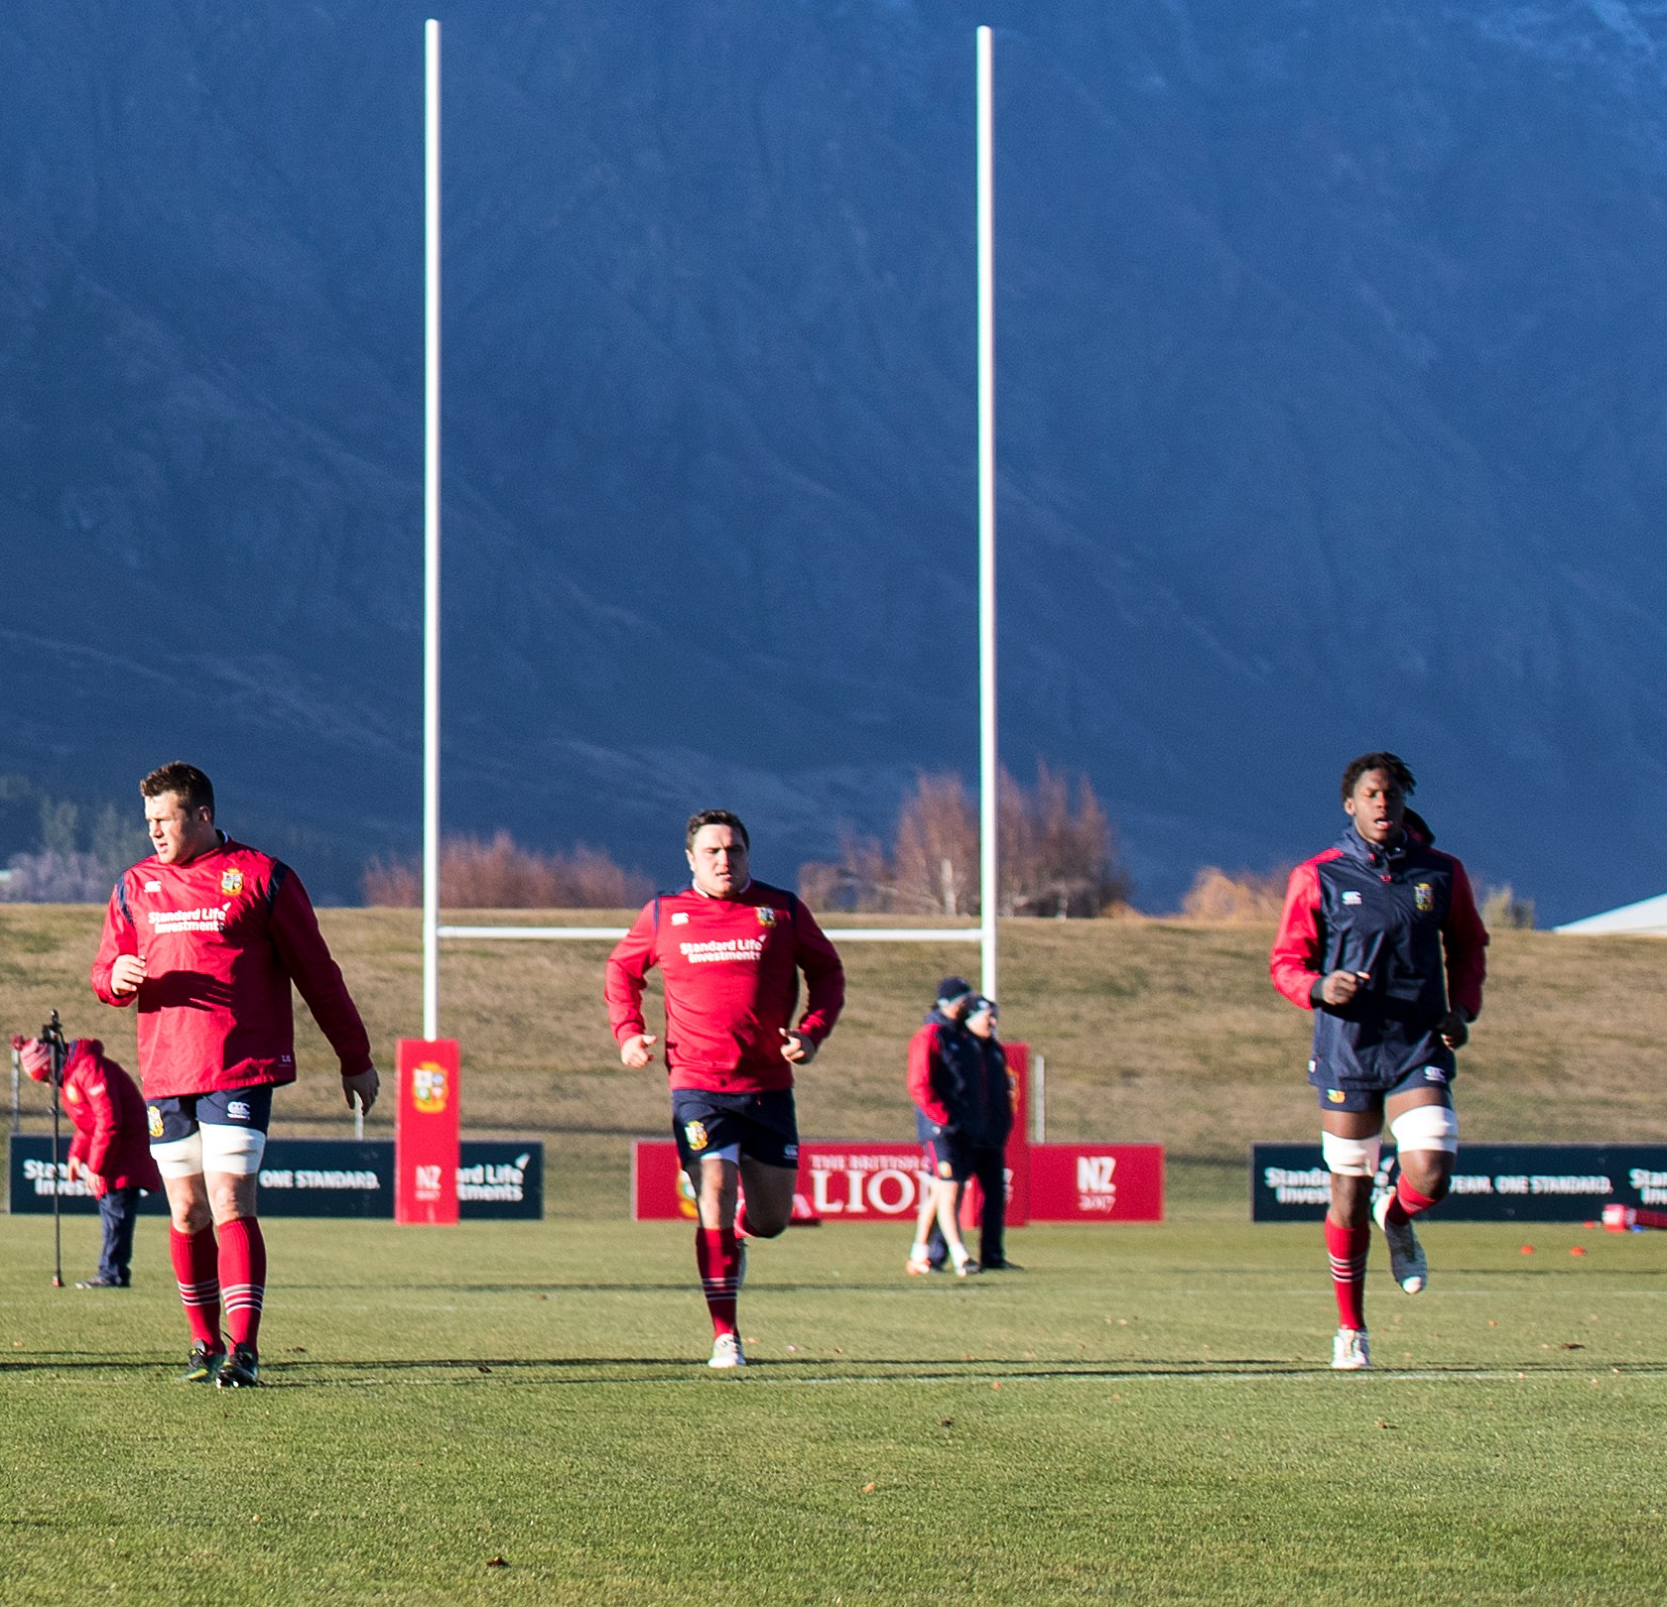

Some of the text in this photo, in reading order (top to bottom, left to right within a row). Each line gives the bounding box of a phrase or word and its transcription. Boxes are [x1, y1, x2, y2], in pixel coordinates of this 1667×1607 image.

[148, 907, 225, 924] Standard Life
[680, 939, 762, 955] Standard Life
[259, 1170, 380, 1189] ONE STANDARD.
[415, 1165, 442, 1188] NZ
[485, 1163, 523, 1184] Life
[1077, 1156, 1116, 1193] NZ
[1264, 1167, 1331, 1188] Standa
[1495, 1175, 1529, 1194] ONE
[1530, 1176, 1614, 1194] STANDARD.
